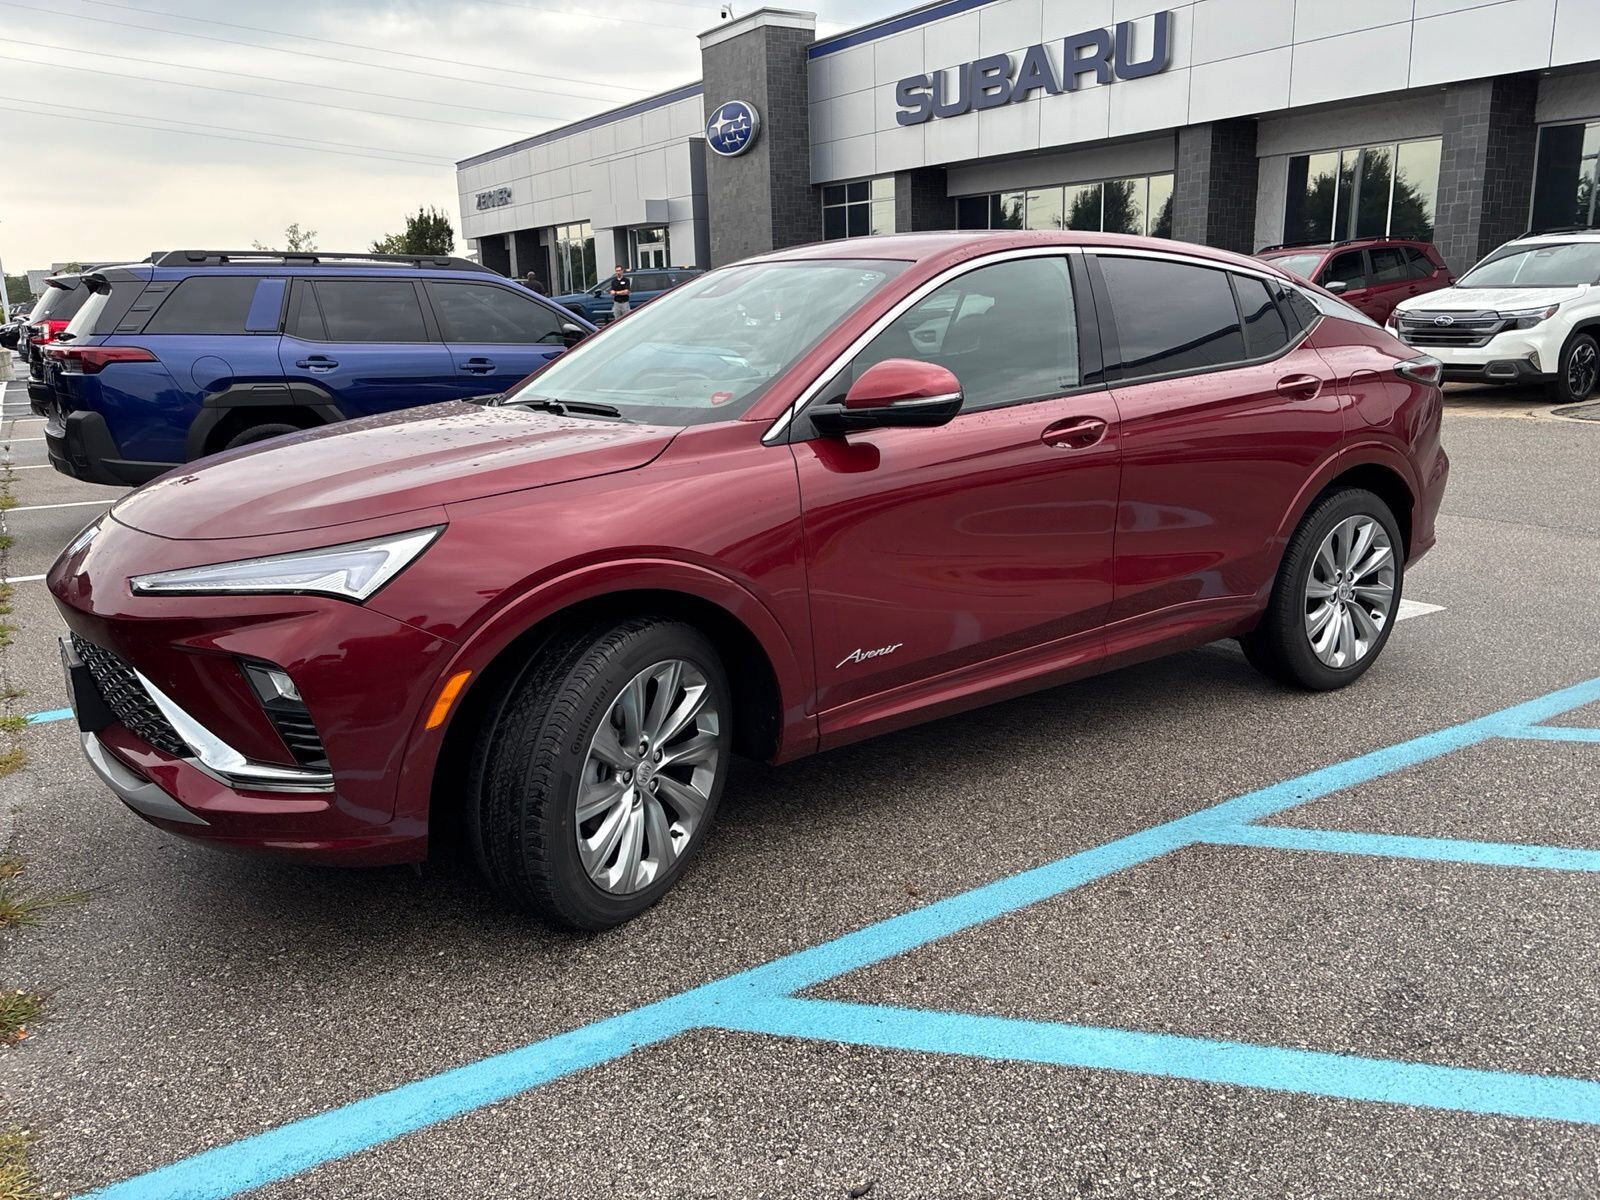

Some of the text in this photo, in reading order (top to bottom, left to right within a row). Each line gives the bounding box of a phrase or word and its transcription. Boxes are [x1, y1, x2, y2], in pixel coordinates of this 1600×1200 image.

[896, 10, 1173, 126] SUBARU
[835, 643, 903, 669] Avenir
[571, 686, 608, 755] Continental
